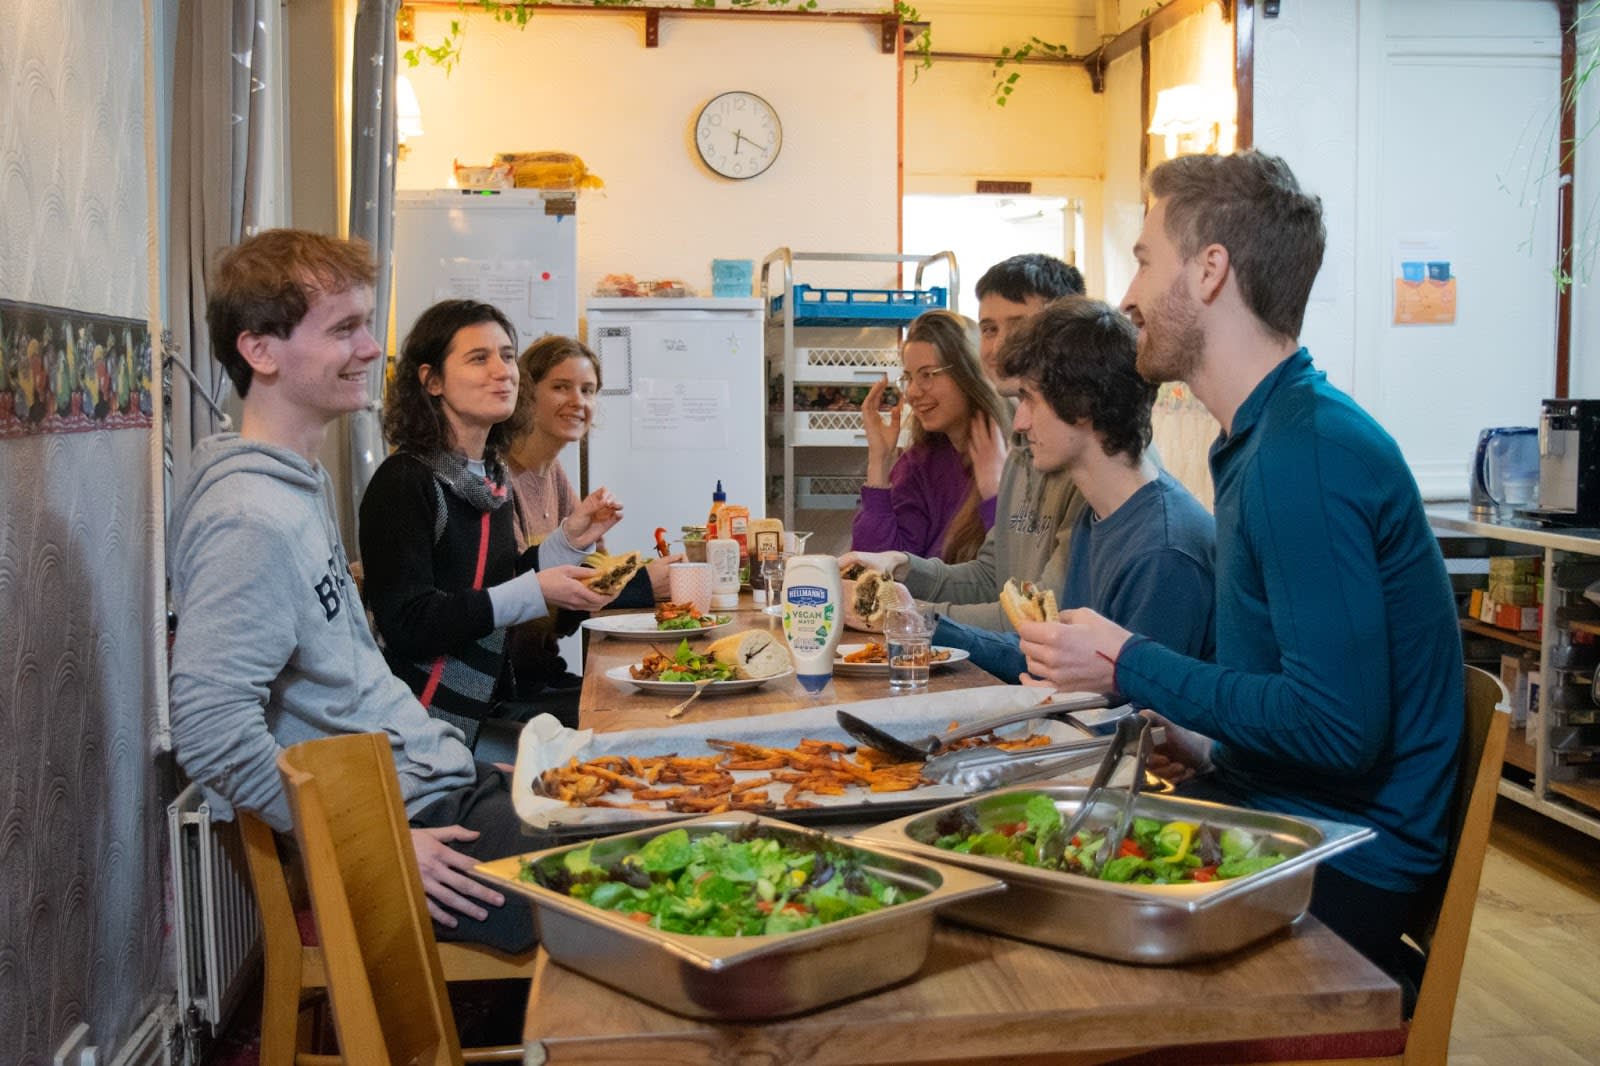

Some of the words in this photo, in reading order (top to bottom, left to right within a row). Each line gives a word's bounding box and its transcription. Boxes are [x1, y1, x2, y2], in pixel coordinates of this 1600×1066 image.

[733, 97, 747, 111] 12
[704, 113, 722, 127] 10
[792, 611, 822, 619] VEGAN
